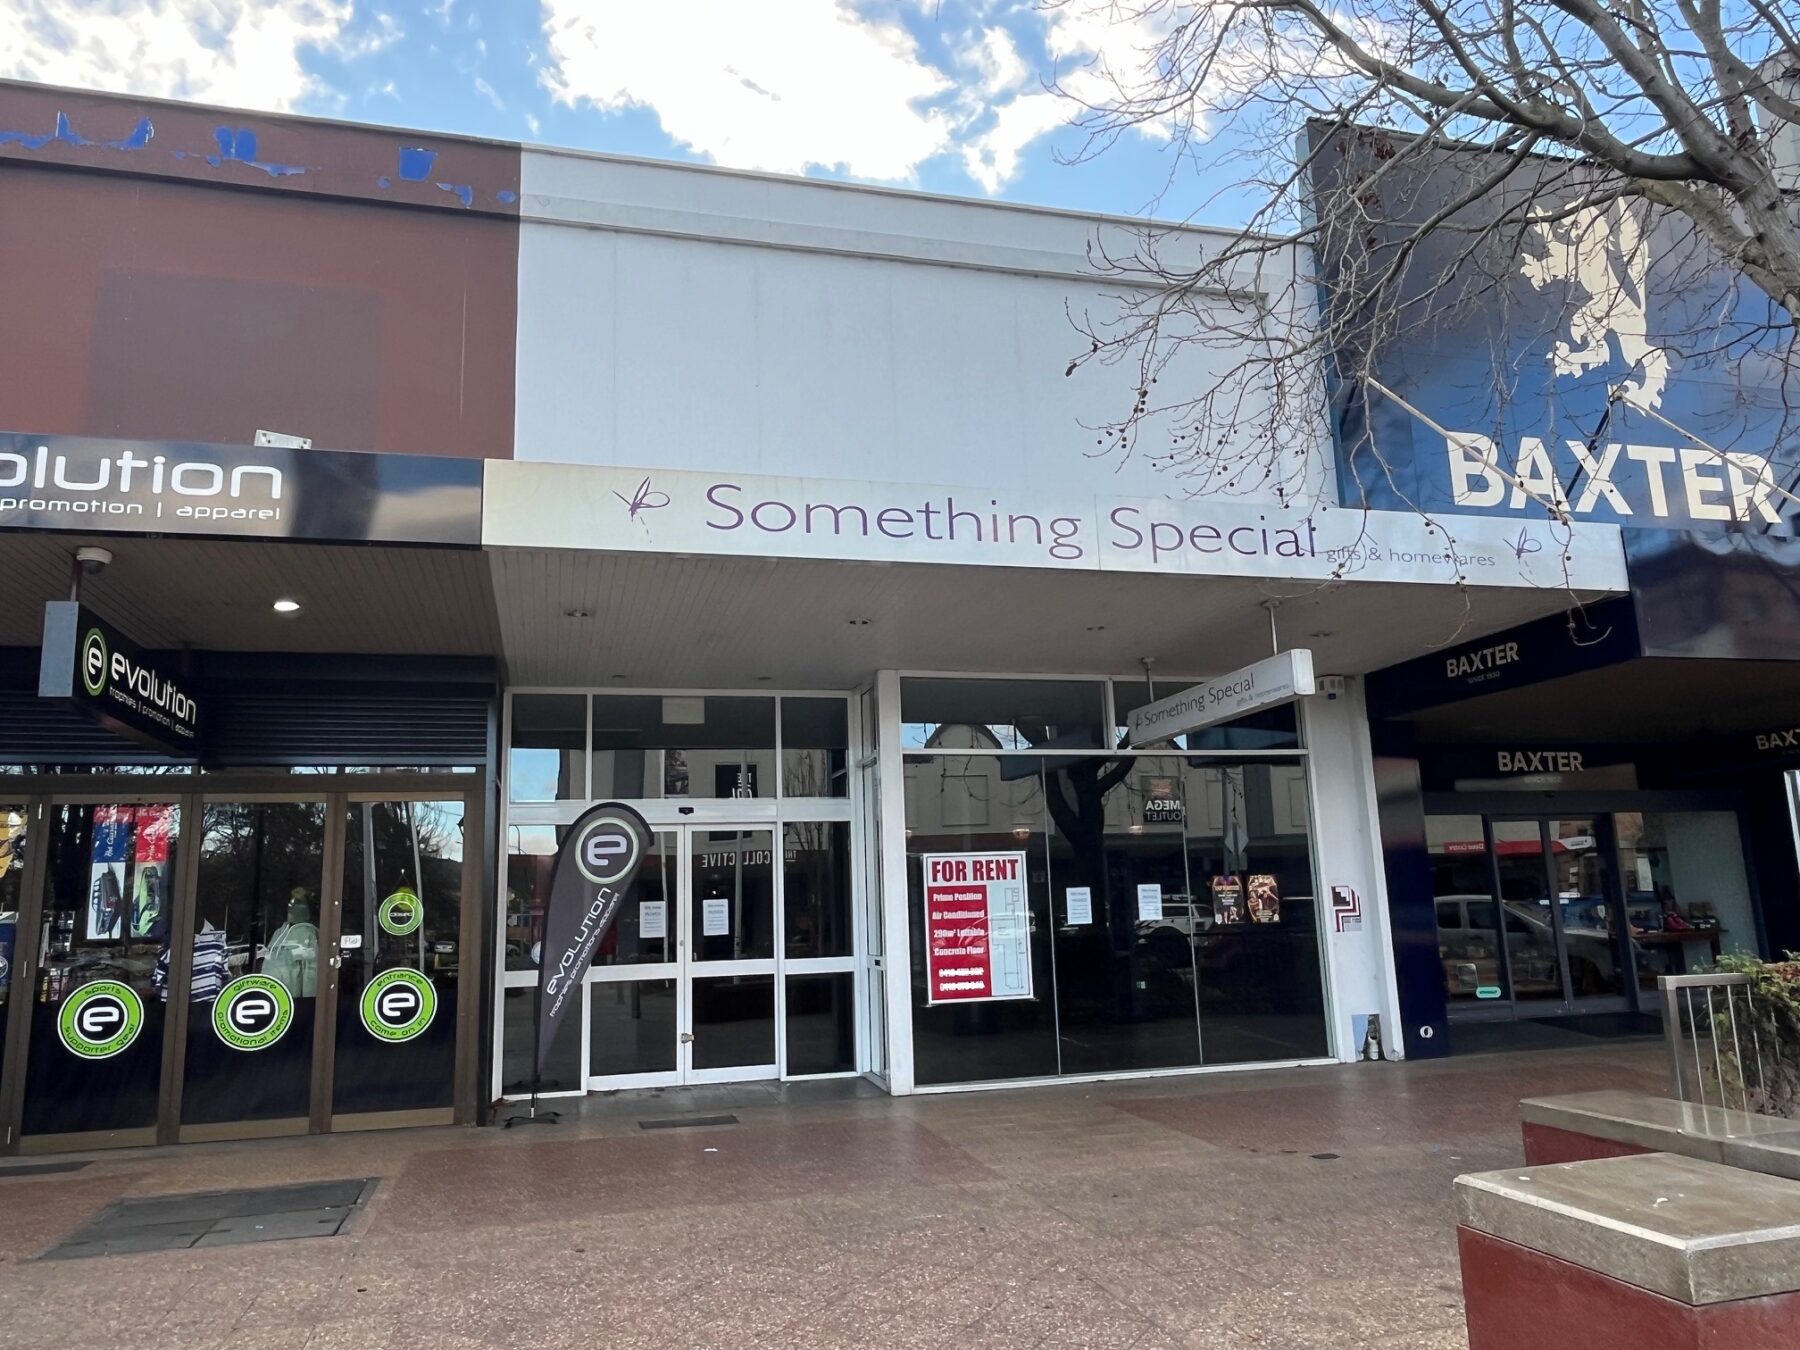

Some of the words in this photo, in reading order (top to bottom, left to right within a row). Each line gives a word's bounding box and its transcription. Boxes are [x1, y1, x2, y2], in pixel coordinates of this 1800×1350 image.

[1446, 431, 1784, 524] BAXTER
[0, 498, 143, 515] promotion
[176, 505, 280, 520] apparel
[705, 484, 1084, 560] Something
[1110, 506, 1317, 563] Special
[1326, 545, 1361, 563] gifts
[1368, 547, 1382, 561] &
[1446, 642, 1520, 678] BAXTER
[111, 652, 196, 725] evolution
[1144, 695, 1205, 727] Something
[1208, 672, 1255, 705] Special
[1498, 751, 1584, 772] BAXTER
[587, 834, 627, 866] e
[931, 860, 967, 883] FOR
[972, 859, 1019, 881] RENT
[933, 894, 954, 902] Prime
[954, 893, 983, 901] Position
[932, 911, 943, 920] Air
[943, 910, 985, 919] Conditioned
[934, 947, 966, 956] Concrete
[966, 946, 984, 955] Floor
[84, 985, 121, 996] sports
[233, 979, 277, 992] giftware
[377, 973, 423, 987] entrance
[236, 999, 271, 1024] e
[382, 992, 416, 1017] e
[83, 1006, 119, 1032] e
[217, 1011, 268, 1046] promotional
[270, 1009, 289, 1037] items
[370, 1020, 396, 1037] come
[401, 1027, 416, 1036] on
[417, 1017, 427, 1027] in
[65, 1026, 112, 1053] supporter
[116, 1023, 136, 1046] gear
